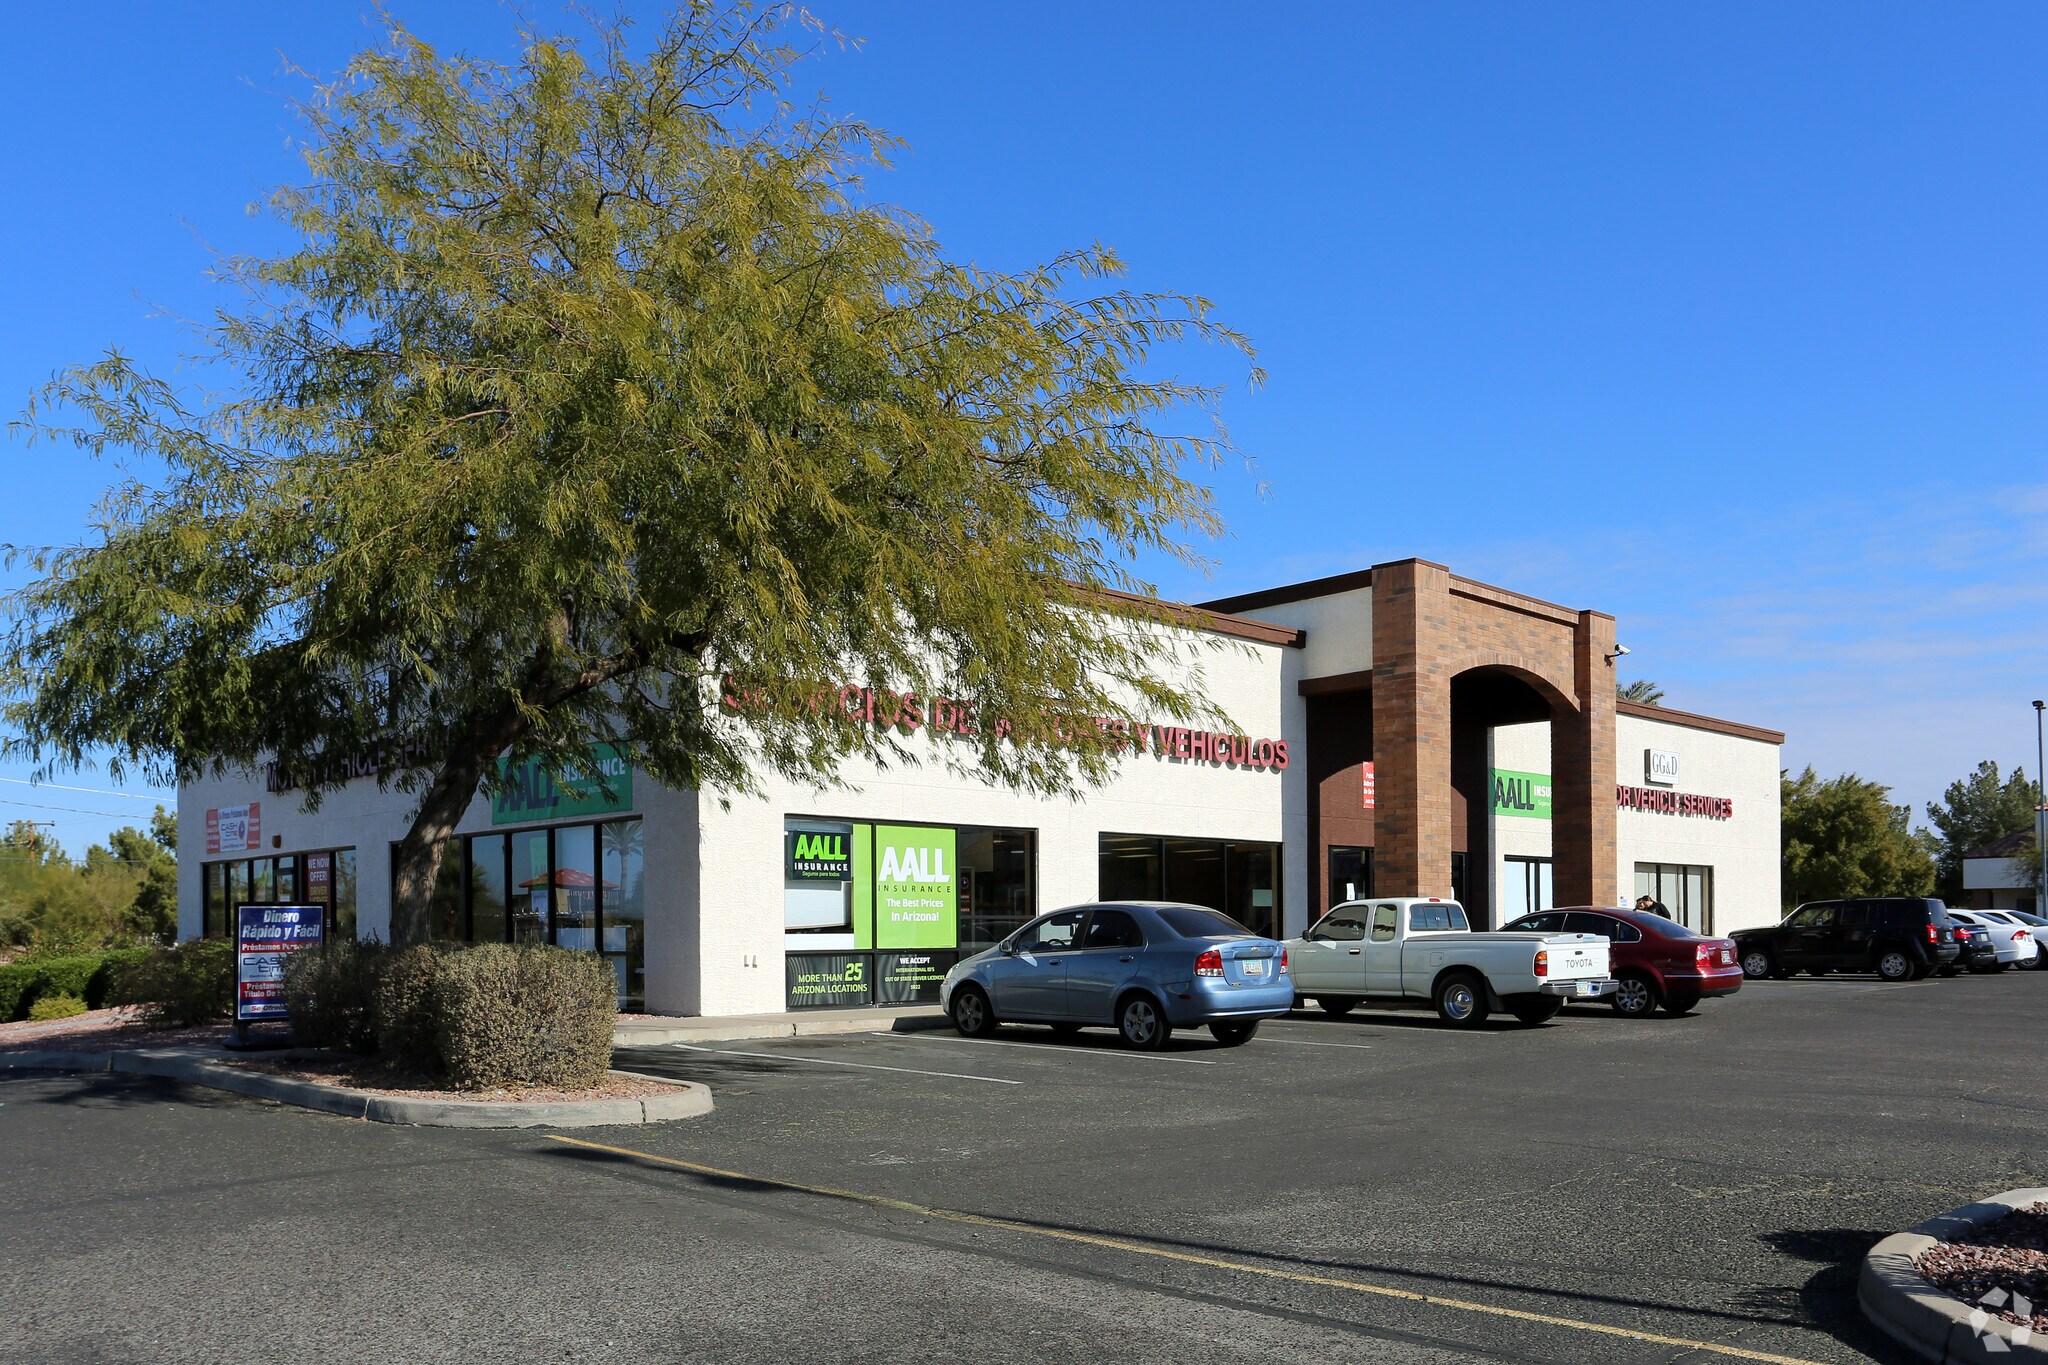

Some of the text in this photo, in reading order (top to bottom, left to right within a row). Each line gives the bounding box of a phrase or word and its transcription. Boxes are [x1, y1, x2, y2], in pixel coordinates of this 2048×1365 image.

[935, 695, 977, 735] DE
[1136, 722, 1152, 753] Y
[1158, 725, 1289, 769] VEHICULOS
[1652, 753, 1678, 776] GG&D
[498, 762, 560, 813] AALL
[1494, 776, 1535, 811] AALL
[1633, 787, 1681, 812] VEHICLE
[1683, 793, 1732, 818] SERVICES
[795, 835, 847, 860] AALL
[307, 857, 330, 869] WE NOW
[795, 862, 848, 871] INSURANCE
[879, 847, 951, 882] AALL
[310, 870, 327, 882] OFFER!
[878, 885, 951, 893] INSURANCE
[886, 898, 944, 907] The Best Prices
[263, 909, 300, 923] Dinero
[891, 911, 940, 922] In Arizona!
[242, 924, 320, 940] Rápido y Fácil
[242, 943, 281, 951] Préstamos
[899, 956, 930, 965] WE ACCEPT
[1565, 958, 1593, 968] TOYOTA
[798, 962, 863, 983] MORE THAN 25
[792, 983, 868, 994] ARIZONA LOCATIONS
